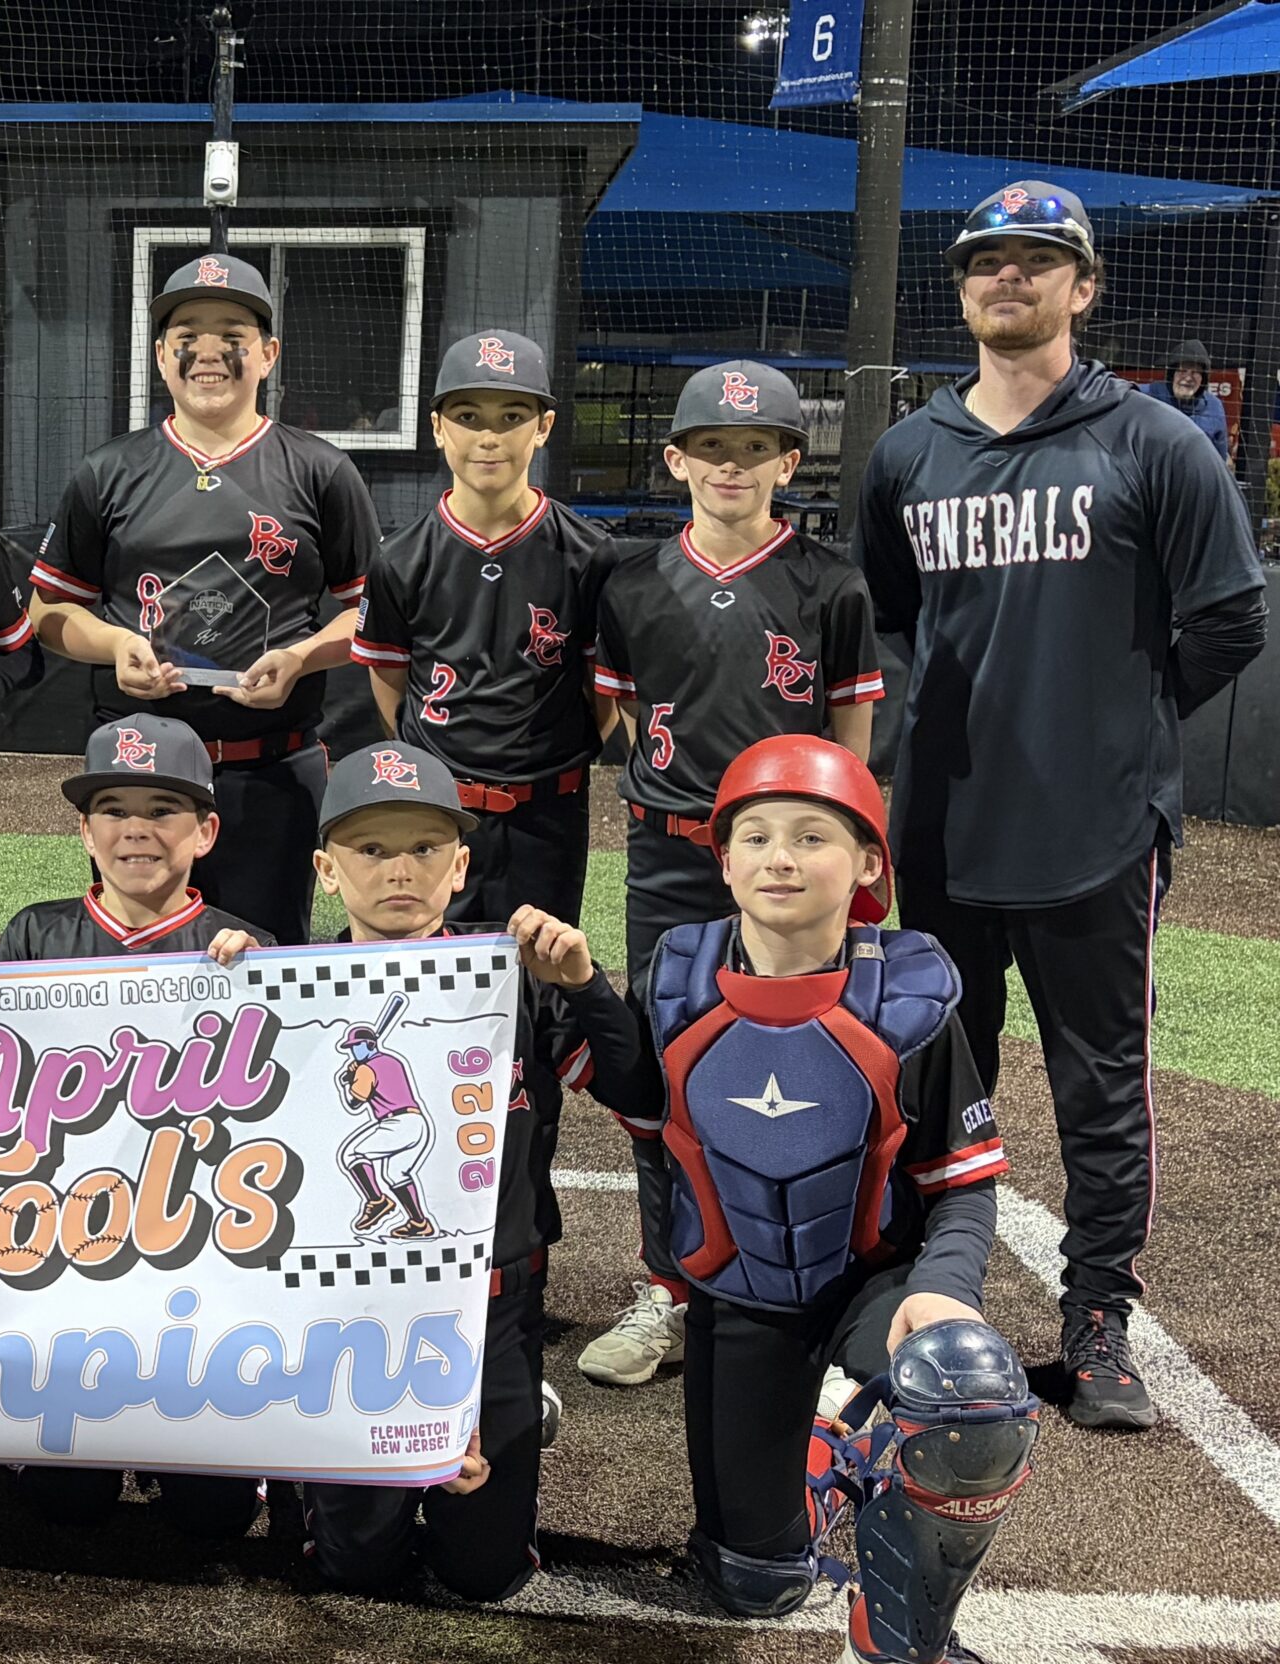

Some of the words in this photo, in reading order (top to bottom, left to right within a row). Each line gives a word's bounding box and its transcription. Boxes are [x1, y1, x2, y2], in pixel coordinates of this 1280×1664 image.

[812, 14, 836, 62] 6
[903, 484, 1094, 573] GENERALS
[136, 572, 166, 632] 8
[191, 600, 233, 612] NATION
[419, 661, 458, 725] 2
[647, 703, 676, 770] 5
[119, 975, 232, 1005] nation
[448, 1046, 496, 1192] 2026
[961, 1098, 995, 1134] GENE
[370, 1421, 450, 1440] FLEMINGTON
[371, 1440, 401, 1455] NEW
[404, 1435, 450, 1453] JERSEY
[934, 1494, 1010, 1516] ALL-STAR
